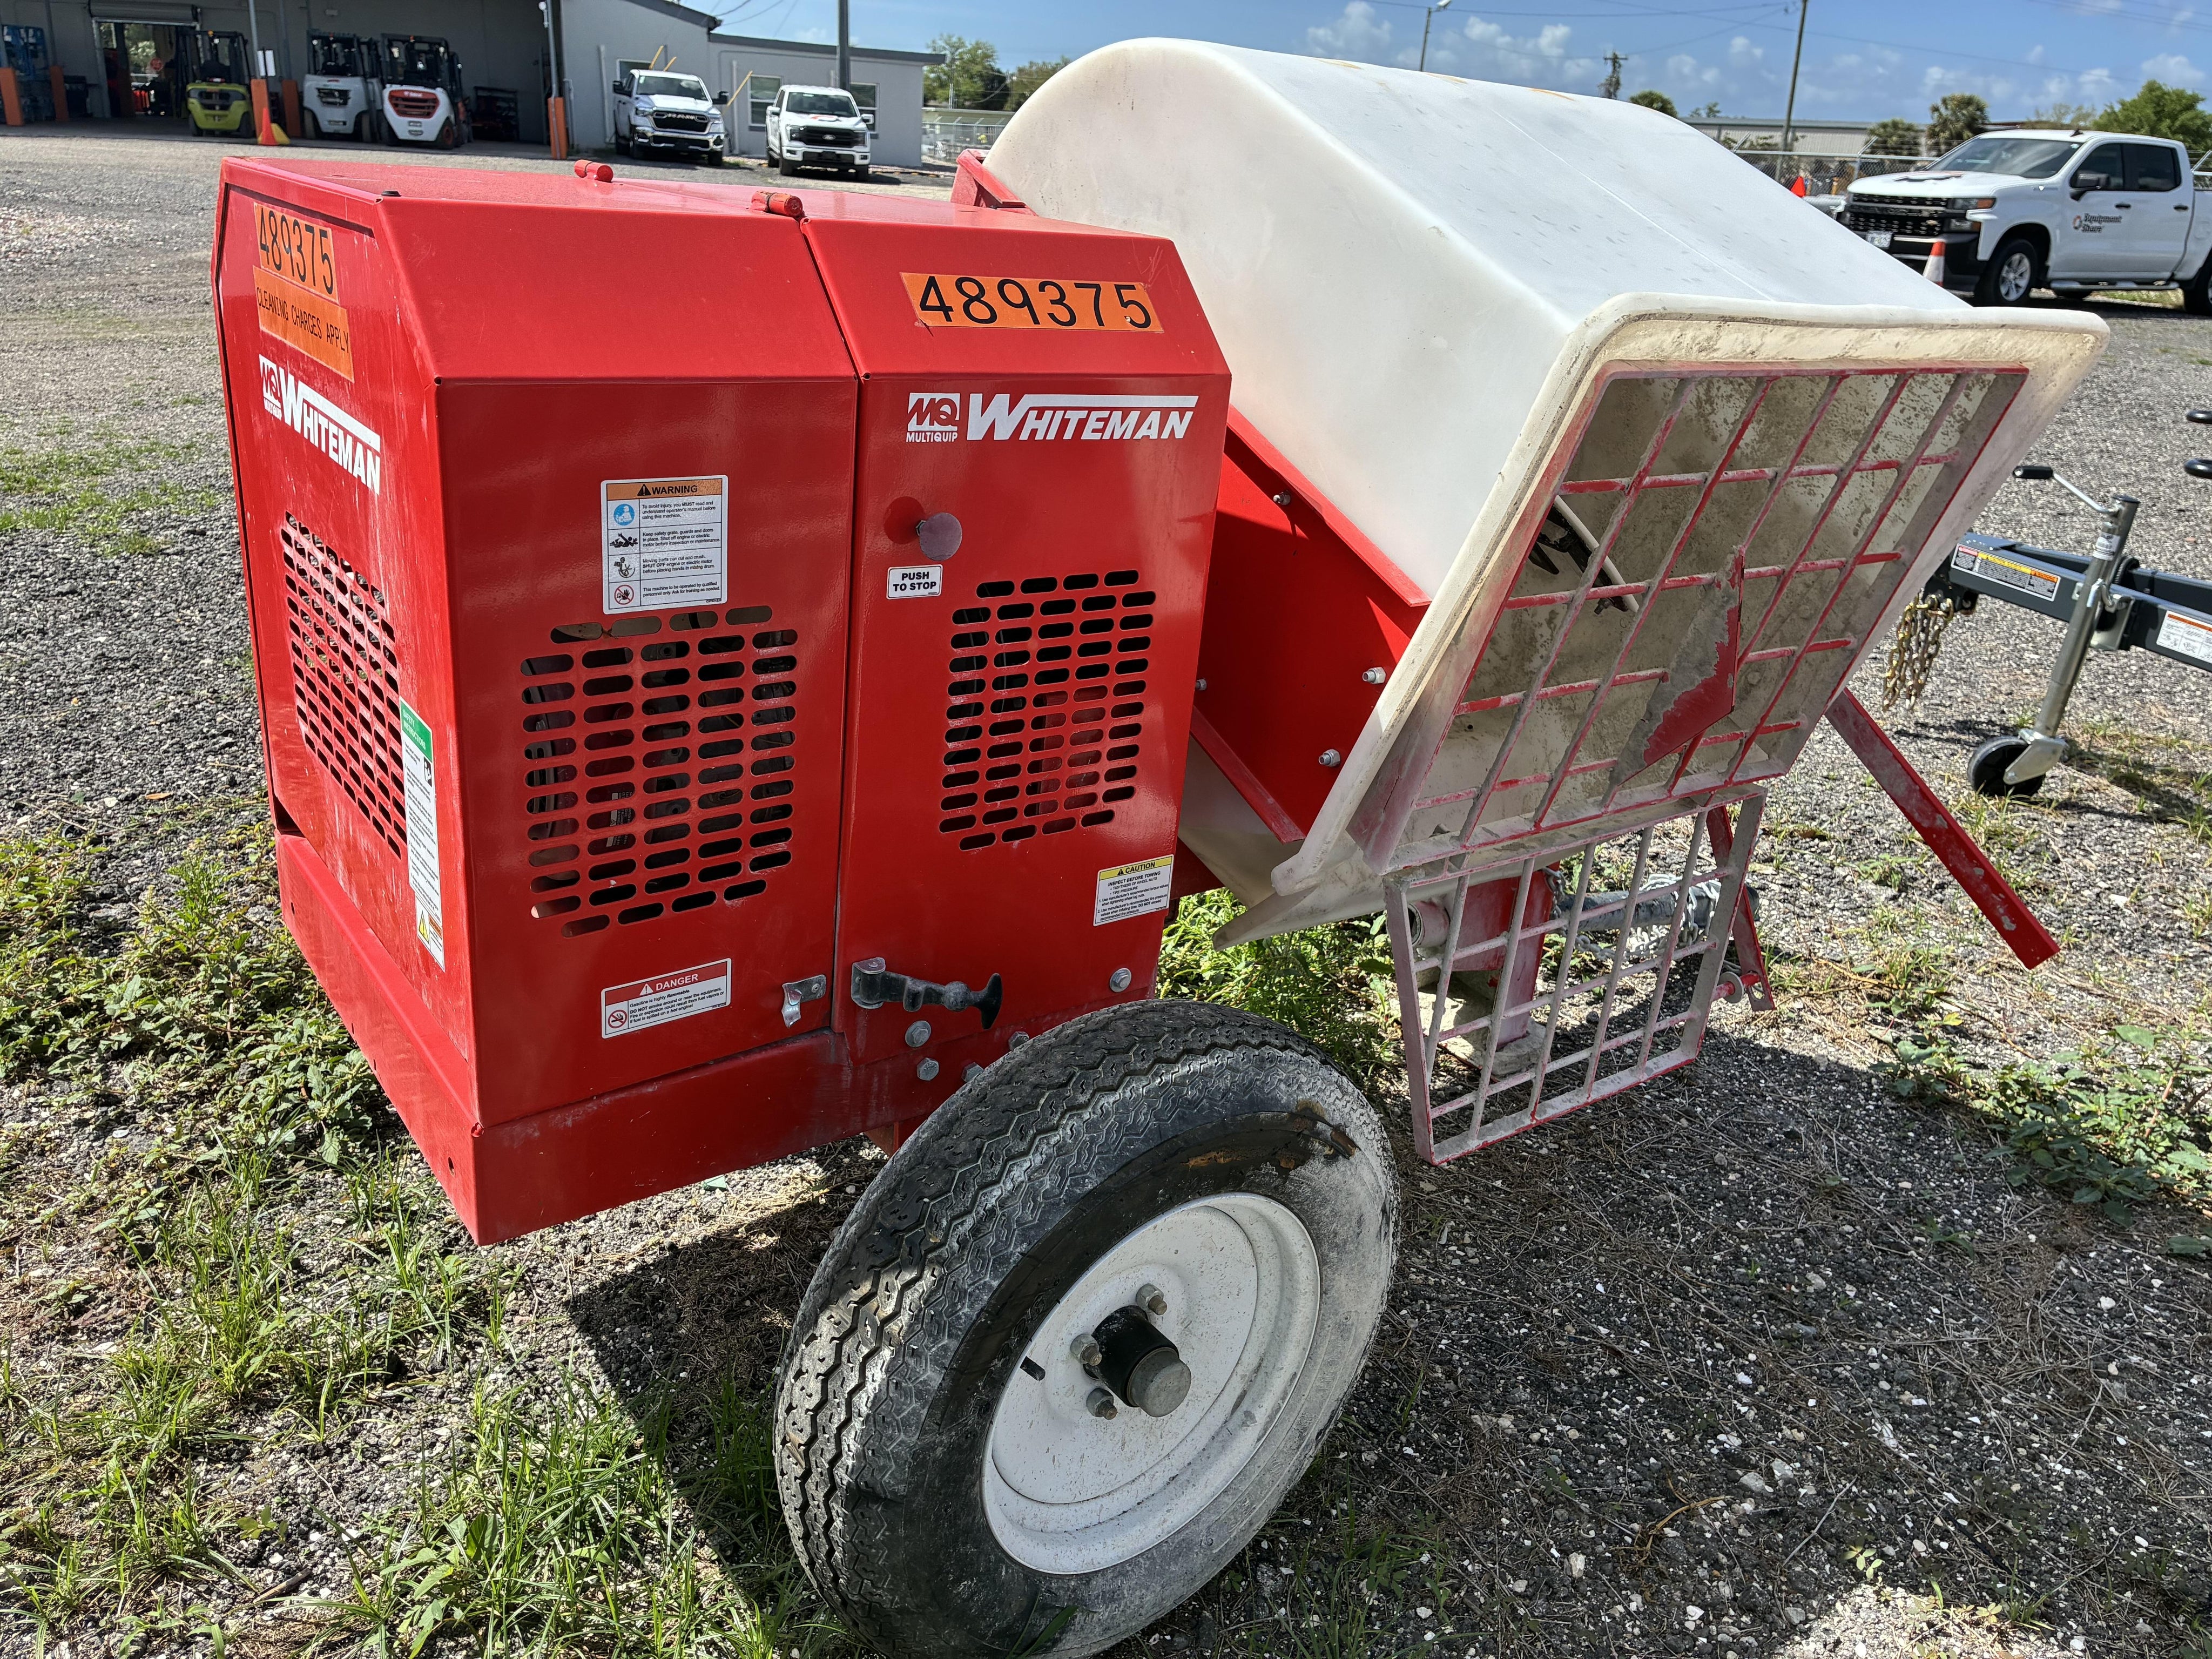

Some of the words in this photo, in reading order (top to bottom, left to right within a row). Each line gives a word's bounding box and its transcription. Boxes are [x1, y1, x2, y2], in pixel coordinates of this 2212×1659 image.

[2084, 212, 2122, 224] Equipment
[259, 207, 333, 294] 489375
[919, 276, 1151, 328] 489375
[256, 287, 289, 321] CLEANING
[291, 305, 322, 339] CHARGES
[326, 322, 349, 353] APPLY
[906, 432, 957, 443] MULTIQUIP
[652, 484, 697, 495] WARNING
[901, 571, 929, 581] PUSH
[893, 583, 907, 591] TO
[909, 581, 936, 590] STOP
[1125, 861, 1155, 873] CAUTION
[656, 973, 698, 990] DANGER
